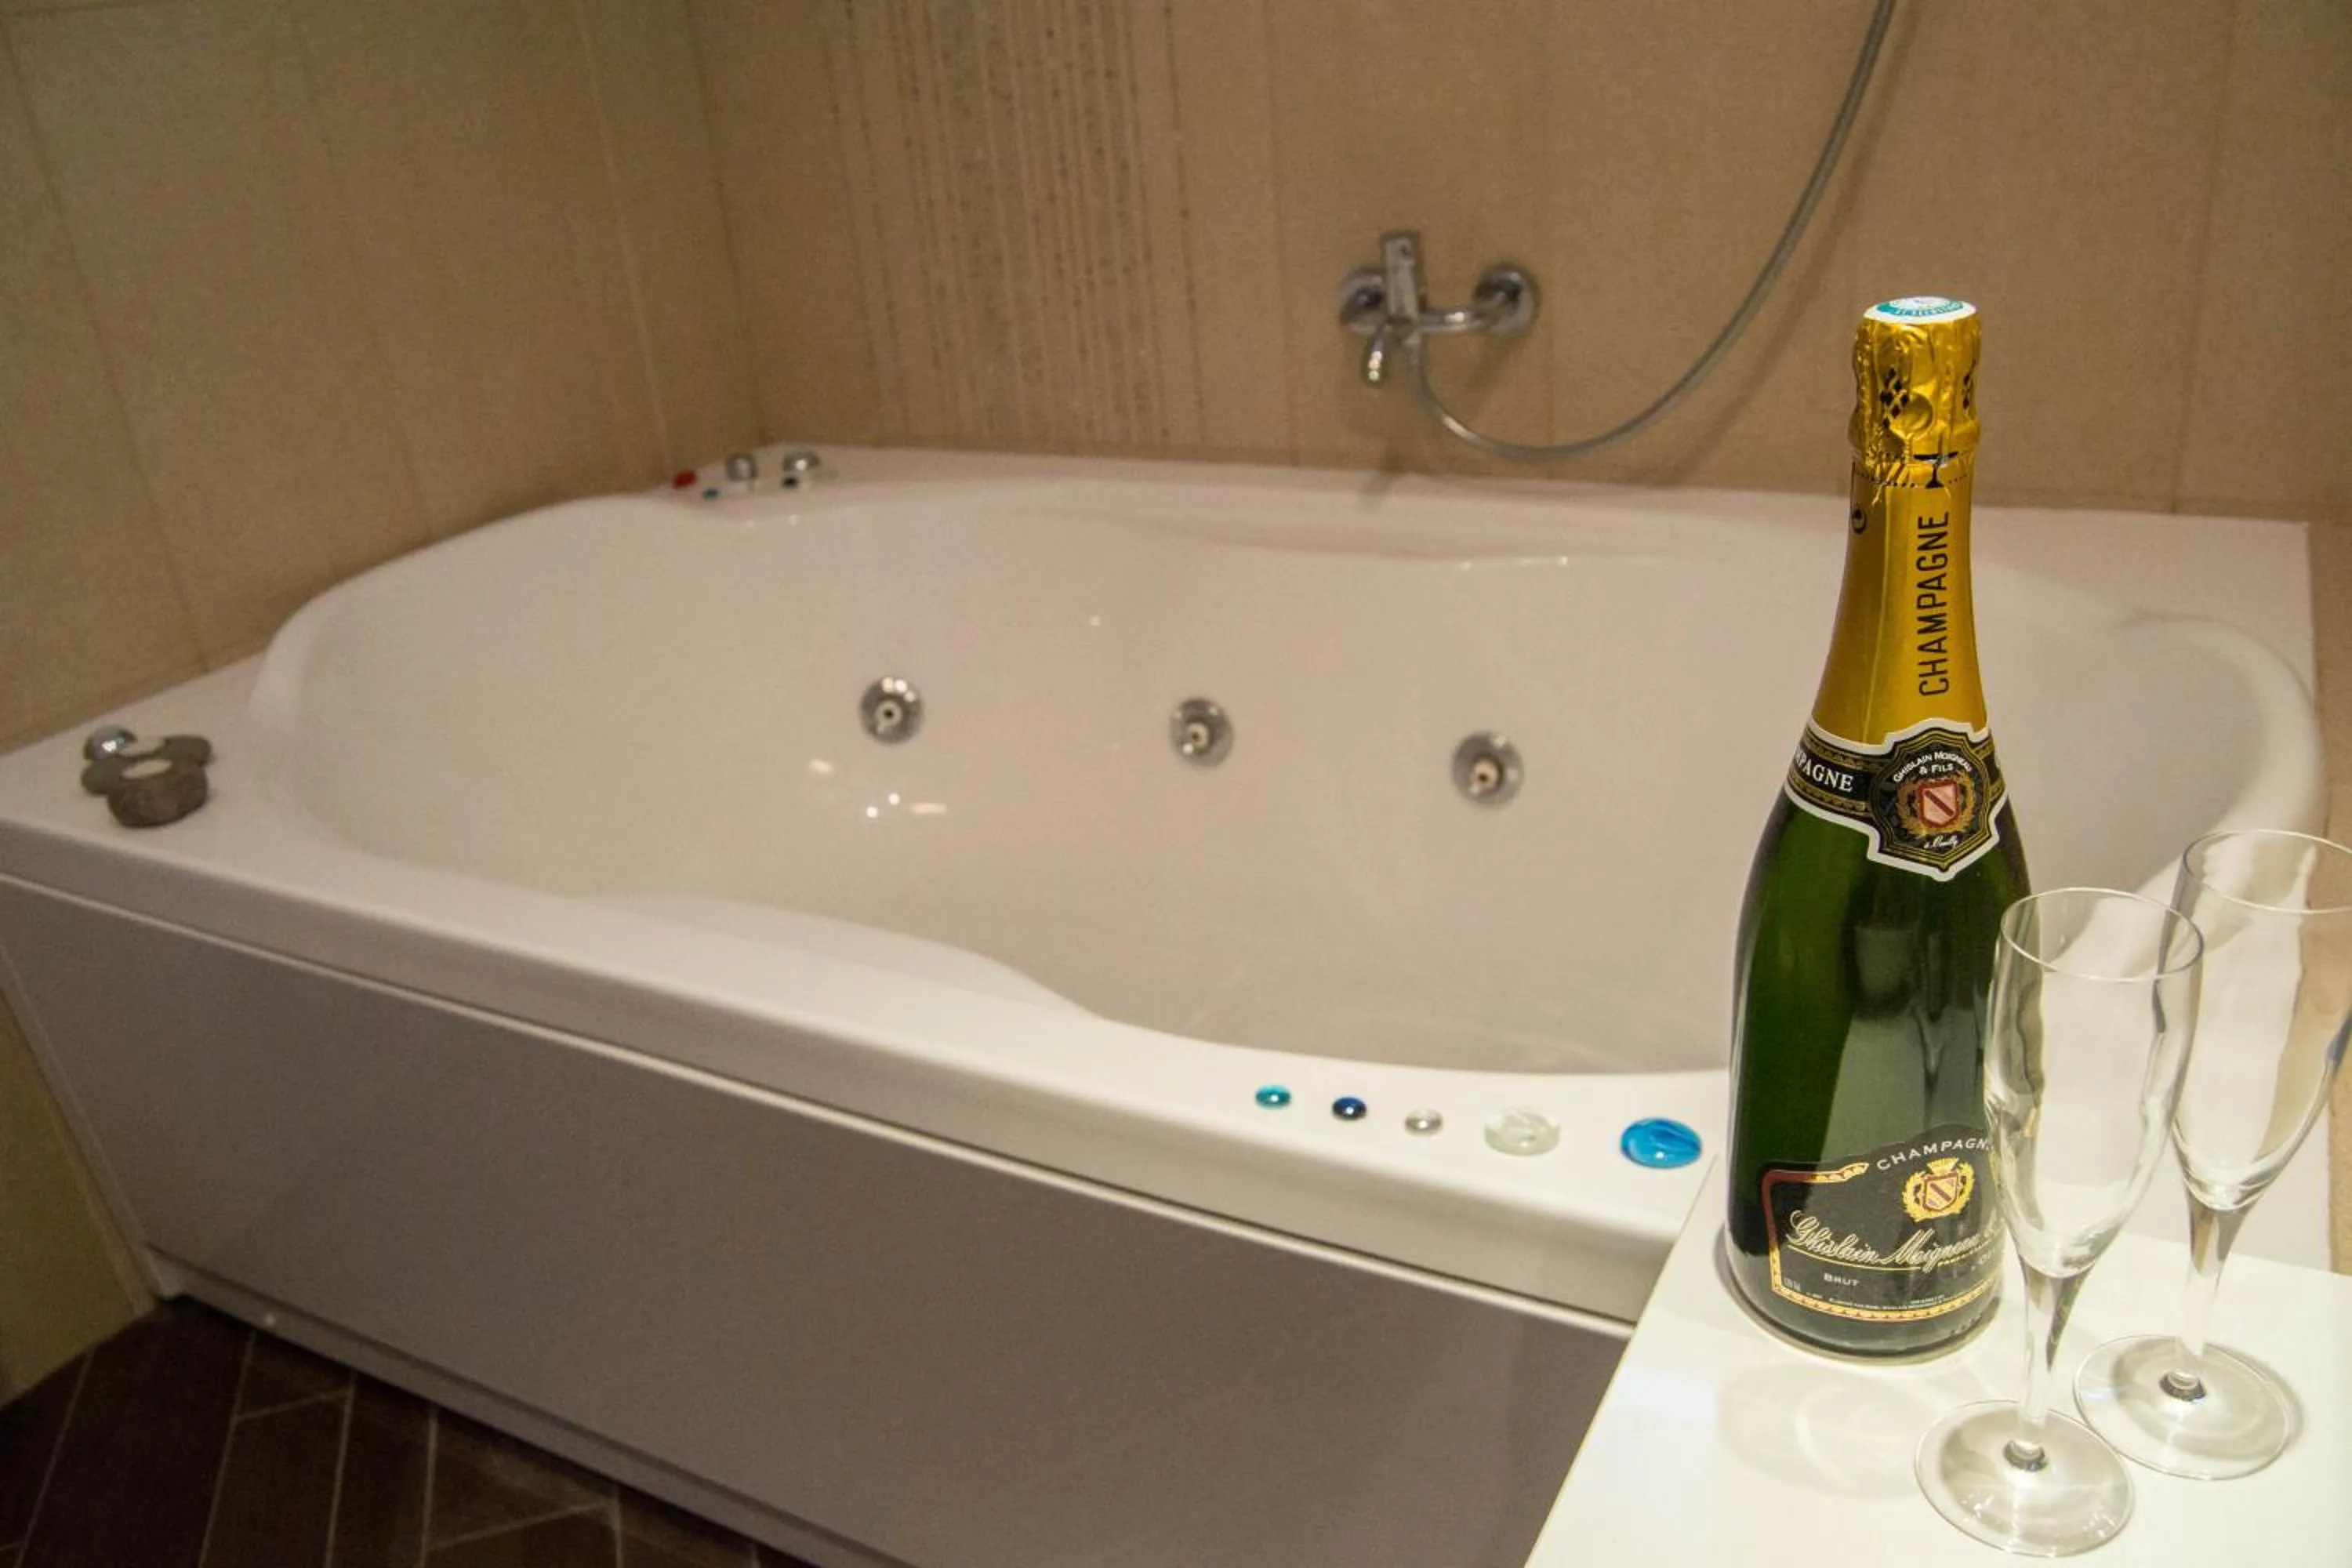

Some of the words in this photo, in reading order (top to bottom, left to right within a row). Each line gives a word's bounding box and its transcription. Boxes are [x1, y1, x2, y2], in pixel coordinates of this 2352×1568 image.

[1916, 511, 1950, 696] CHAMPAGNE
[1893, 753, 1933, 782] GHISLAIN
[1919, 765, 1928, 775] &
[1931, 763, 1954, 774] FILS
[1877, 1137, 1994, 1171] CHAMPAGN
[1823, 1272, 1860, 1287] BRUT
